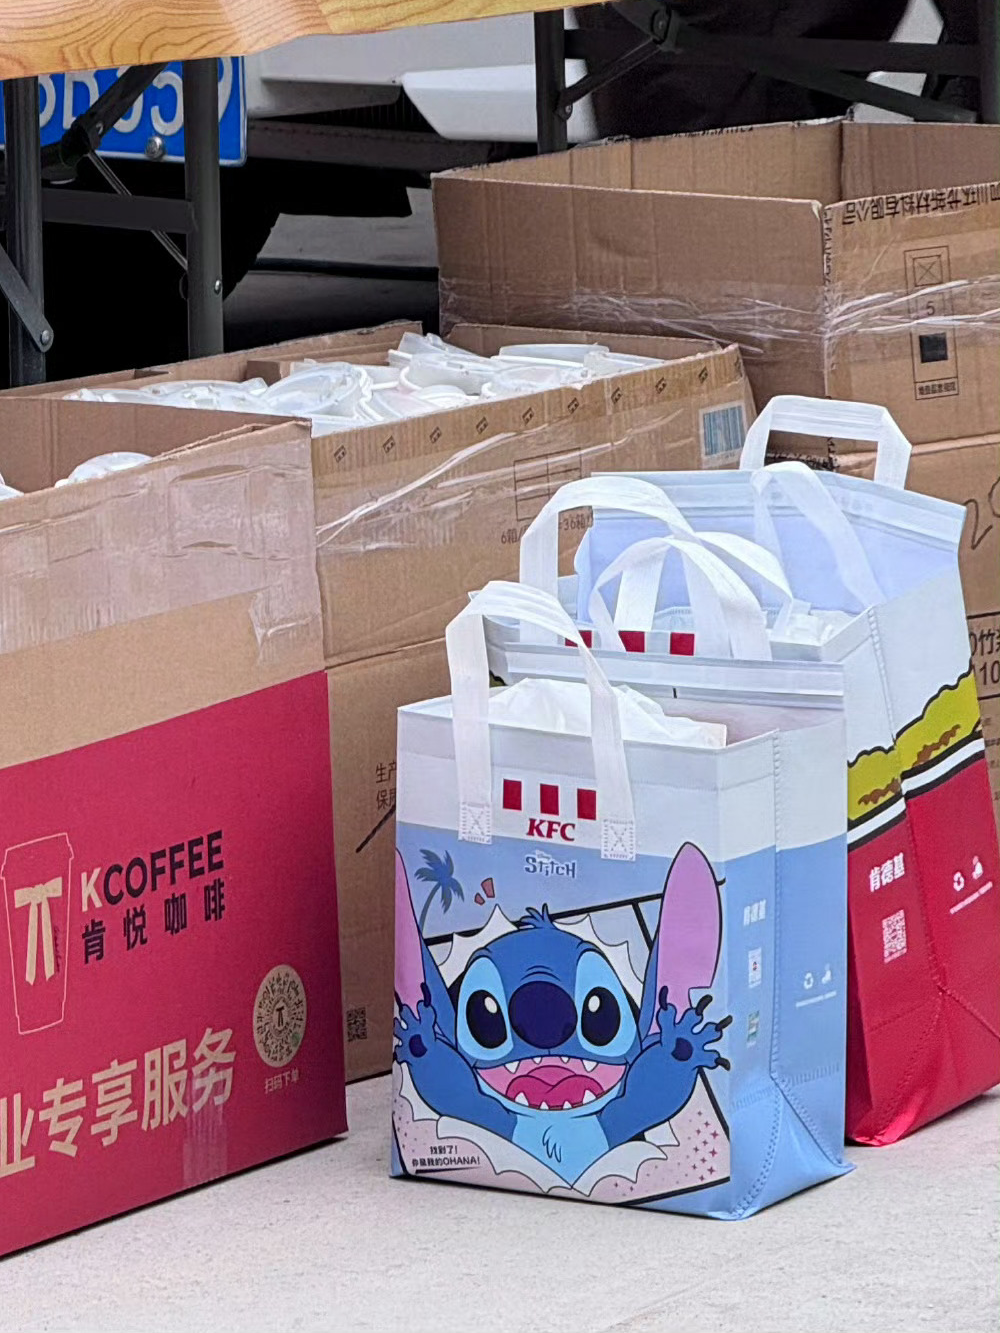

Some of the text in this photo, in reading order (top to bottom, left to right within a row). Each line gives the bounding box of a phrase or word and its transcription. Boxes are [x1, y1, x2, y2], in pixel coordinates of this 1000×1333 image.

[926, 301, 935, 316] 5
[526, 818, 576, 841] KFC
[81, 830, 224, 912] KCOFFEE
[870, 853, 905, 892] 肯德基
[82, 878, 226, 964] 肯悦咖啡
